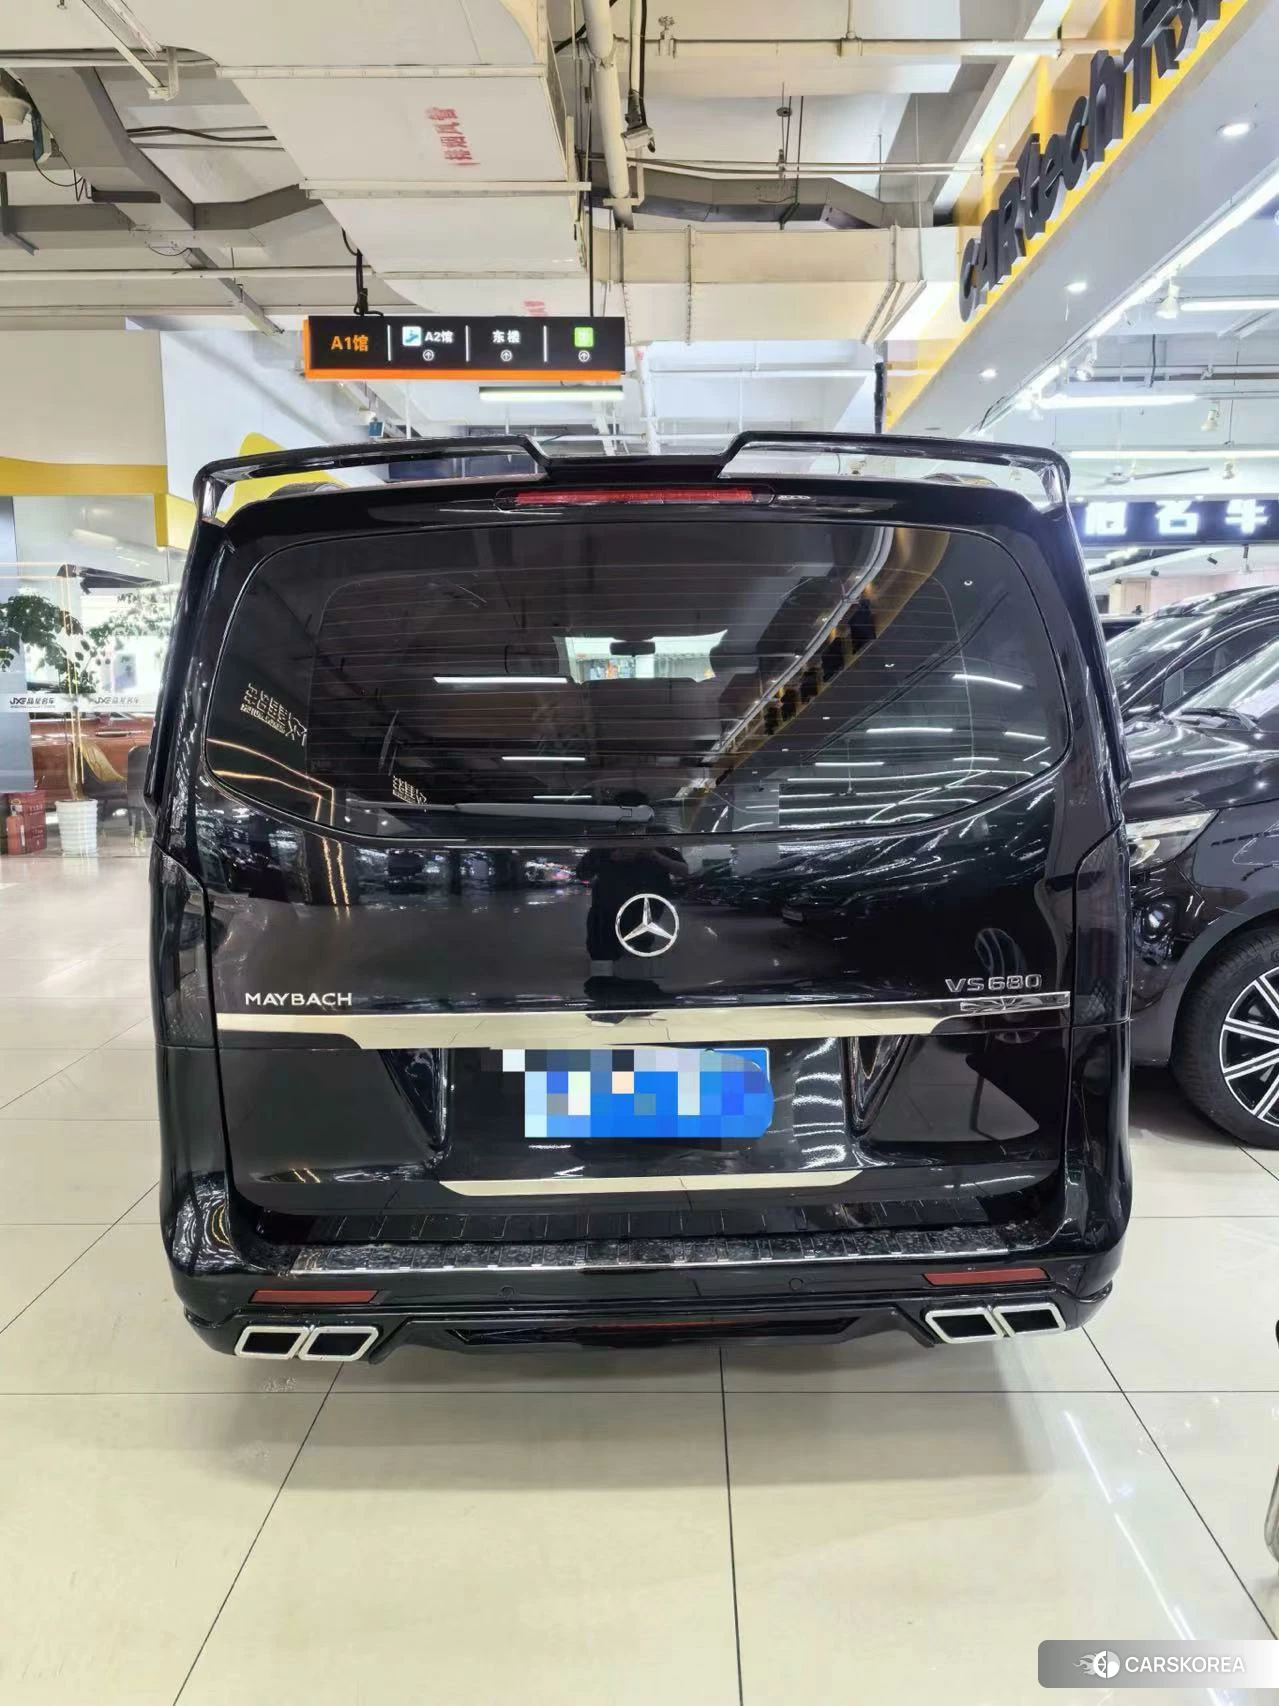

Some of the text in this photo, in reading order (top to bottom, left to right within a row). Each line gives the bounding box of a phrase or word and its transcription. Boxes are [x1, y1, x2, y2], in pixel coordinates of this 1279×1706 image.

[330, 335, 369, 352] A1馆
[424, 329, 454, 344] A2馆
[244, 992, 352, 1006] MAYBACH
